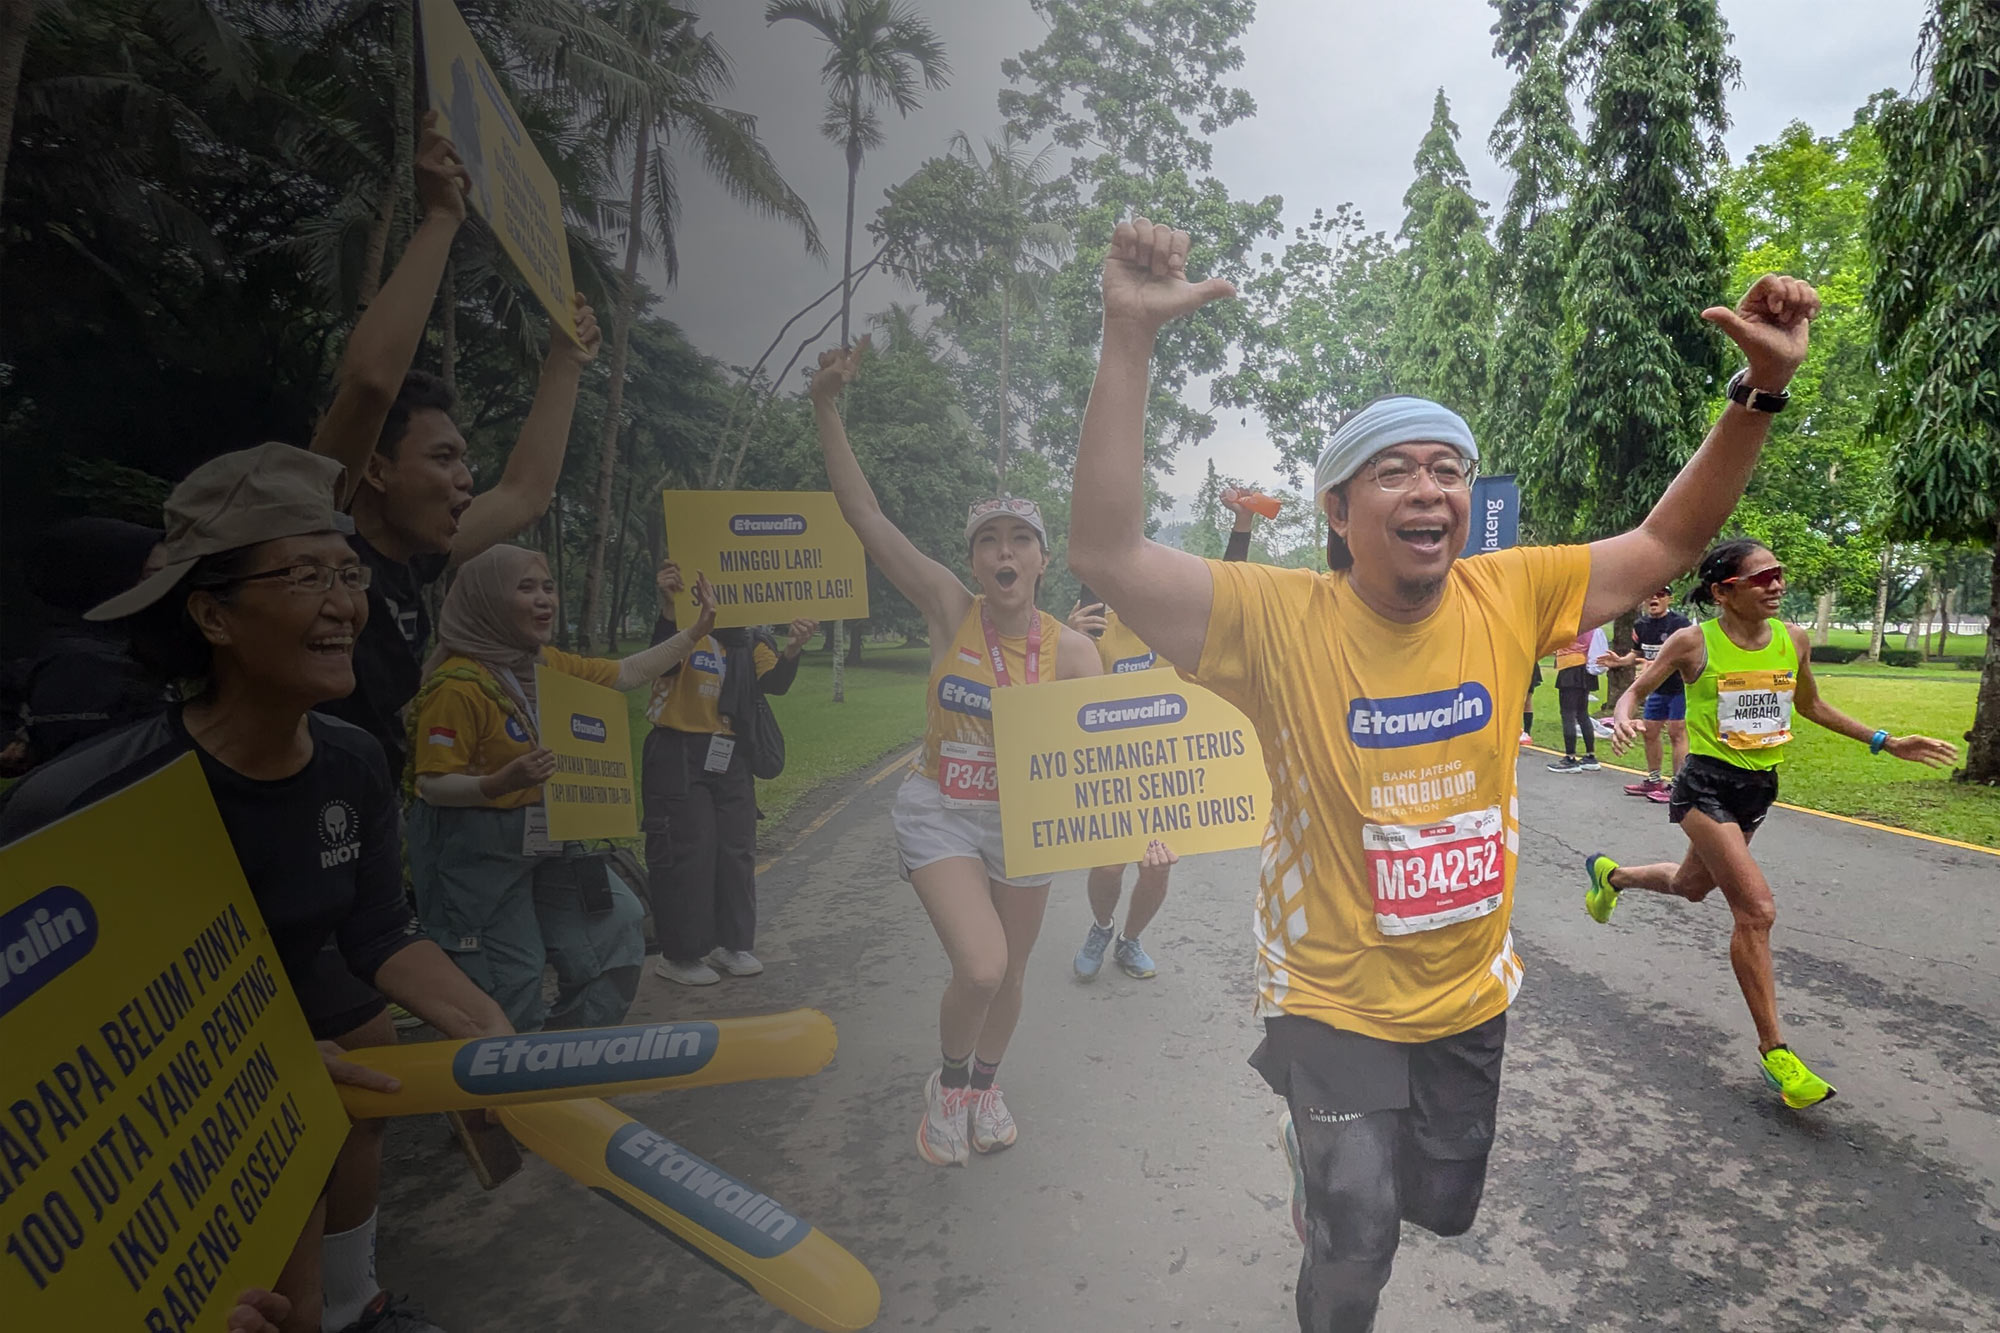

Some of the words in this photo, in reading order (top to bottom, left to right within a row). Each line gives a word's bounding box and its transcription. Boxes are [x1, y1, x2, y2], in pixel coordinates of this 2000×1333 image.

[734, 516, 803, 531] Etawalin
[720, 550, 780, 572] MINGGU
[785, 549, 823, 569] LARI!
[690, 581, 739, 607] SNIN
[743, 581, 813, 603] NGANTOR
[817, 579, 854, 599] LAGI!
[1084, 698, 1181, 726] Etawalin
[1353, 694, 1484, 735] Etawalin
[1734, 706, 1780, 720] NAIBAHO
[1738, 693, 1778, 707] ODEKTA
[556, 754, 584, 774] ARYAWAN
[1029, 751, 1068, 781] AYO
[1074, 737, 1178, 774] SEMANGAT
[1181, 730, 1246, 763] TERUS
[1382, 769, 1417, 782] BANK
[1419, 760, 1463, 779] JATENG
[1075, 779, 1132, 808] NYERI
[1139, 768, 1206, 800] SENDI?
[1371, 770, 1476, 809] BOROBUDUR
[1032, 810, 1133, 848] ETAWALIN
[1137, 806, 1192, 834] YANG
[1199, 795, 1256, 827] URUS!
[1372, 804, 1440, 818] MARATHON
[1375, 841, 1500, 900] M34252
[99, 962, 196, 1078] BELUM
[183, 903, 251, 997] PUNYA
[468, 1026, 703, 1077] Etawalin
[7, 1190, 86, 1291] 100
[70, 1113, 154, 1223] JUTA
[137, 1040, 213, 1139] YANG
[201, 955, 278, 1069] PENTING
[108, 1179, 181, 1293] IKUT
[168, 1042, 280, 1212] MARATHON
[230, 1091, 306, 1225] GISELLA!
[618, 1128, 798, 1242] Etawalin
